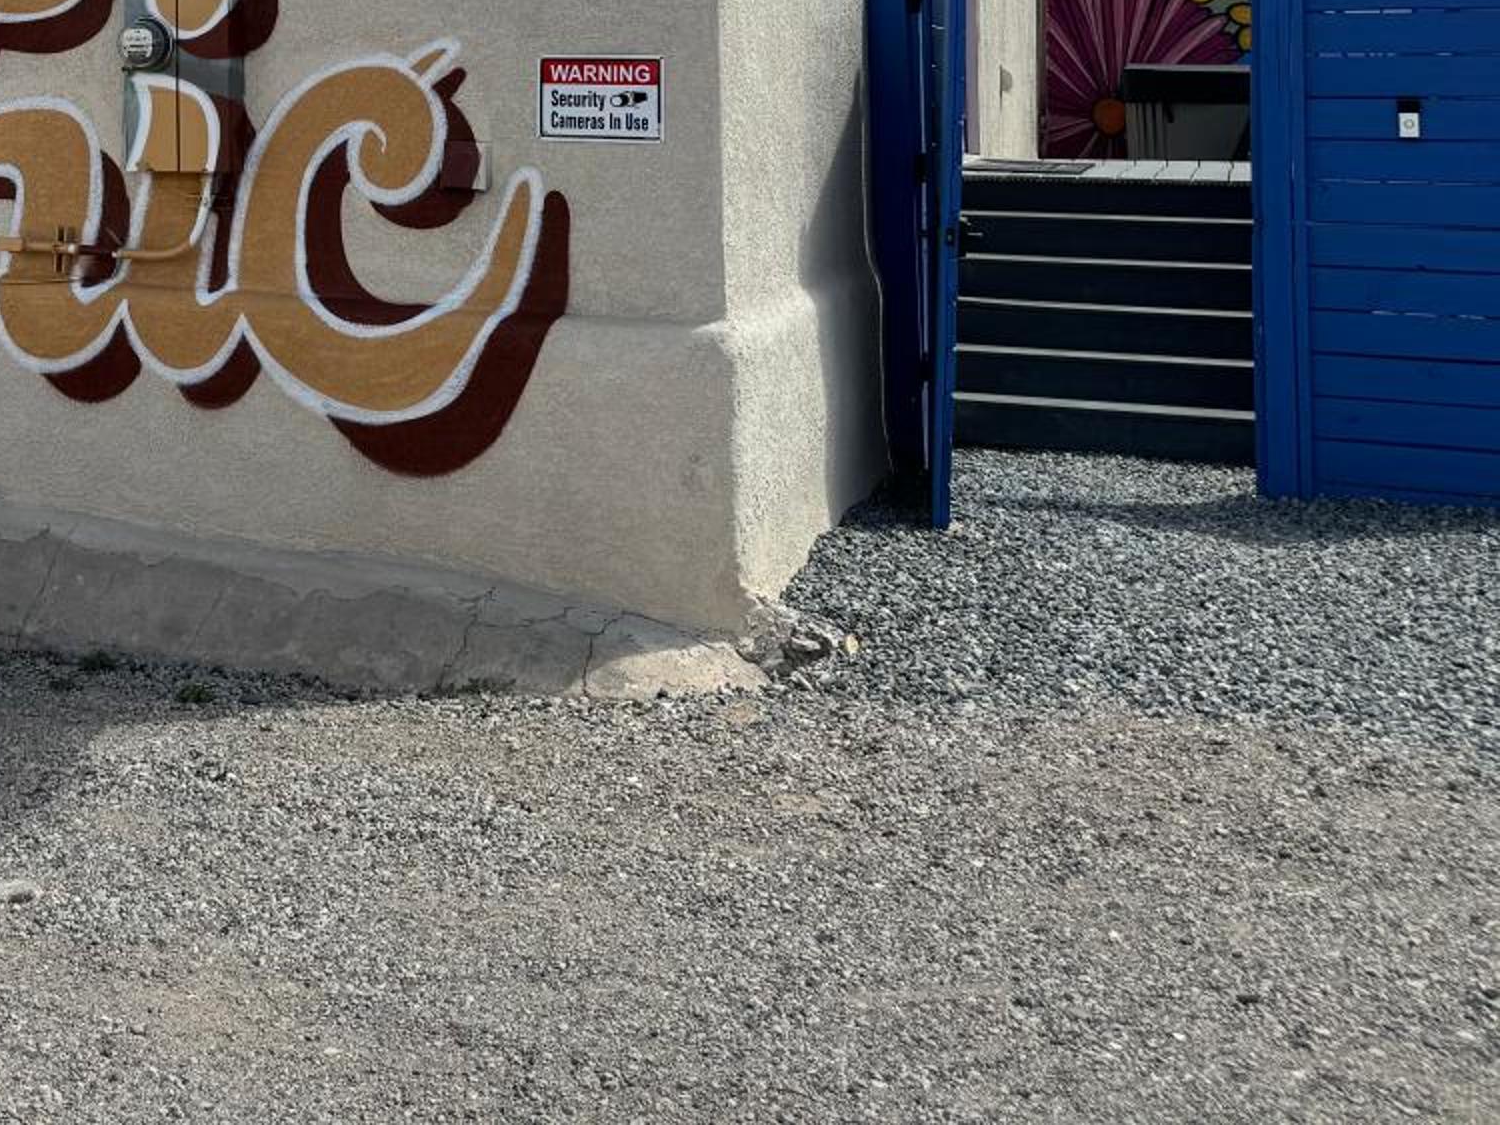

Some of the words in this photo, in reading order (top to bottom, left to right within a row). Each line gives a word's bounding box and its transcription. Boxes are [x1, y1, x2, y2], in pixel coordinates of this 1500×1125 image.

[550, 64, 651, 82] WARNING
[551, 90, 606, 111] Security
[551, 112, 605, 130] Cameras
[609, 113, 621, 130] In
[625, 113, 649, 131] Use
